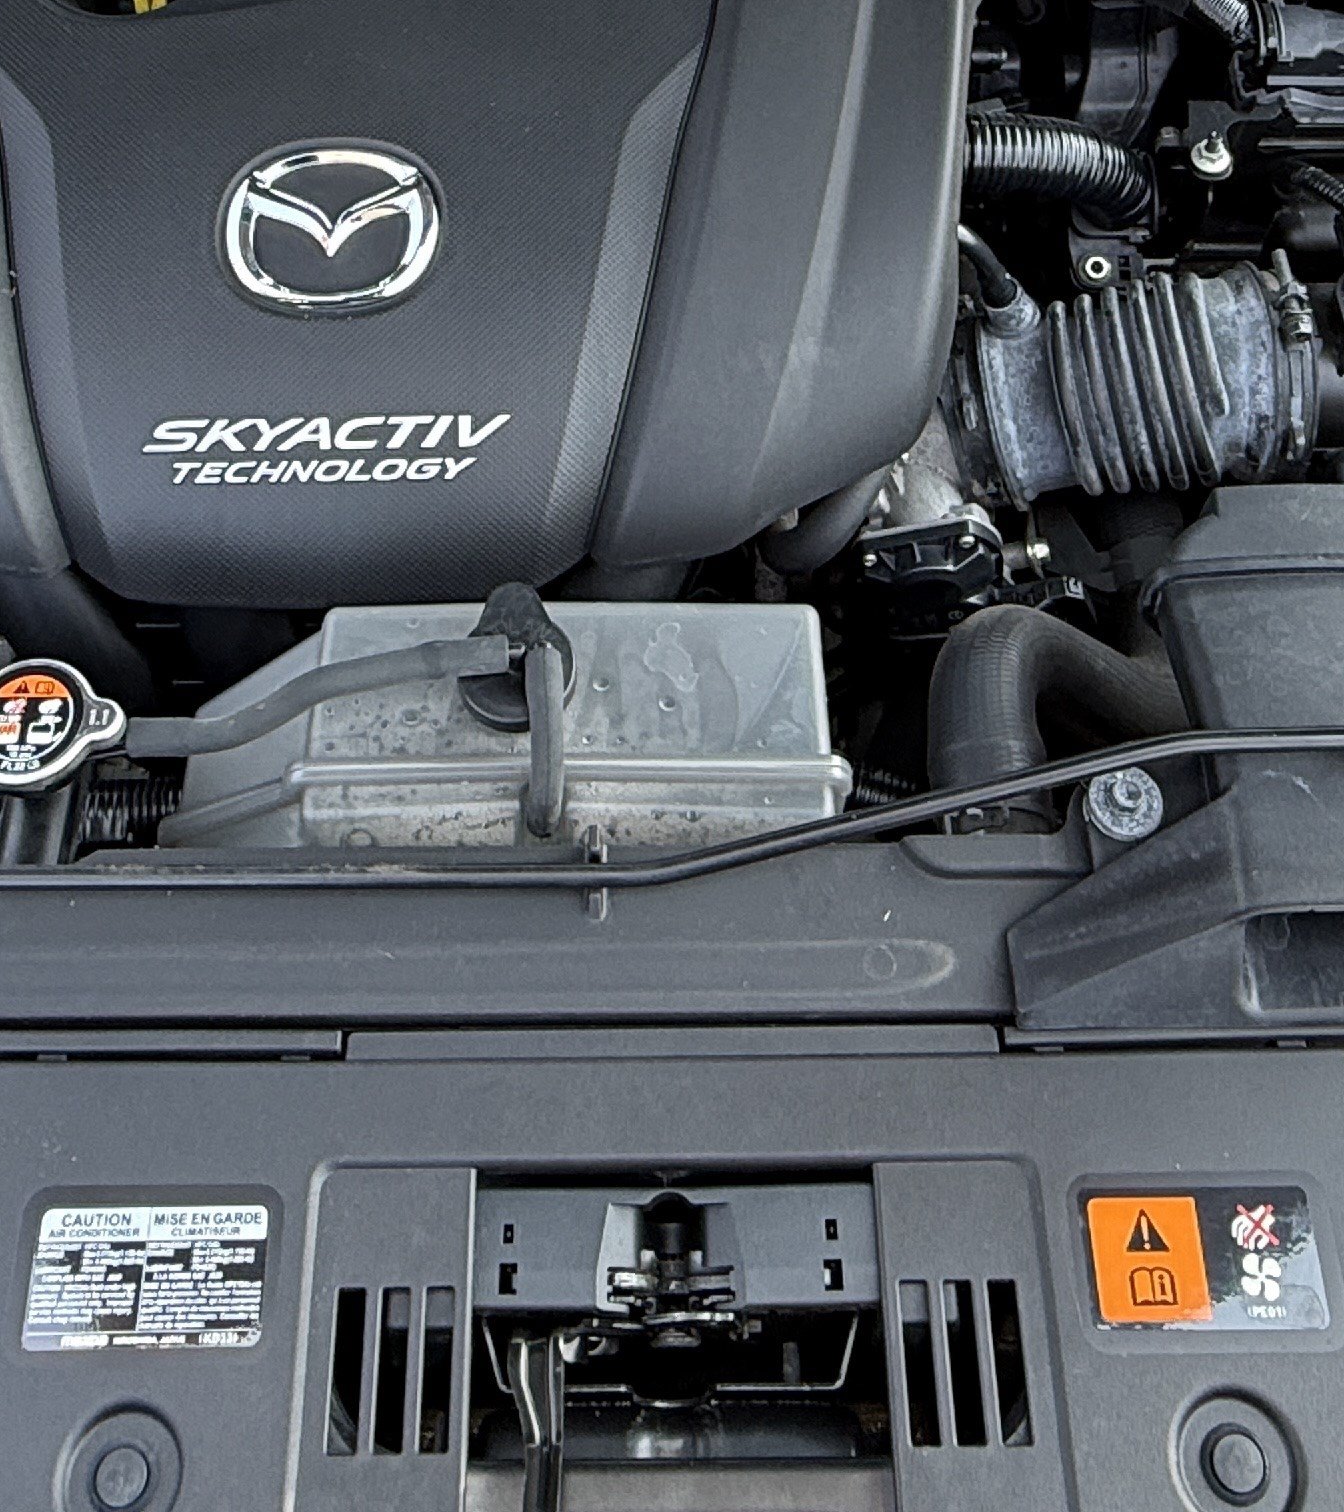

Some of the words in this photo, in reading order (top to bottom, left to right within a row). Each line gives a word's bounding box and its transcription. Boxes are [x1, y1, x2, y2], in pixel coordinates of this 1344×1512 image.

[142, 413, 513, 453] SKYACTIV
[172, 456, 478, 485] TECHNOLOGY
[88, 708, 109, 726] 1.1
[61, 1213, 132, 1229] CAUTION
[154, 1212, 188, 1226] MISE
[191, 1212, 211, 1225] EN
[214, 1210, 262, 1226] GARDE
[48, 1228, 67, 1239] AIR
[69, 1227, 140, 1238] CONDITIONER
[171, 1226, 241, 1238] CLIMATISEUR
